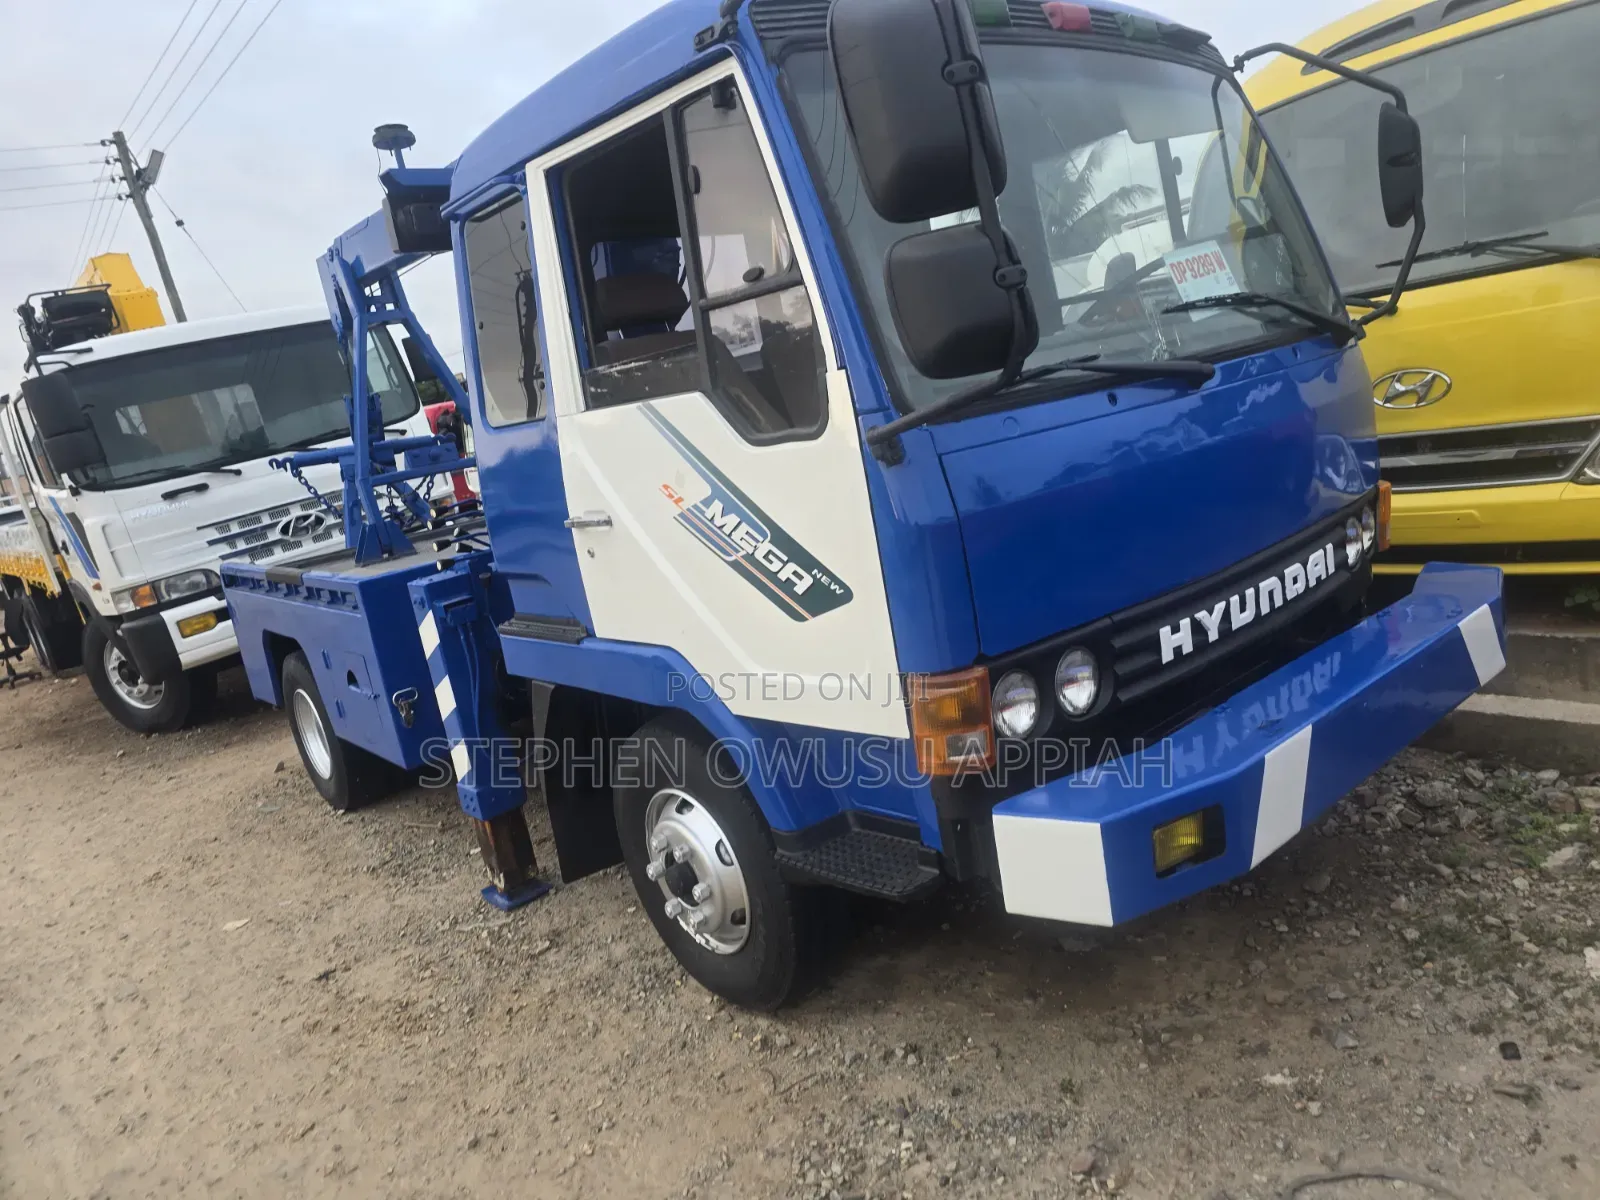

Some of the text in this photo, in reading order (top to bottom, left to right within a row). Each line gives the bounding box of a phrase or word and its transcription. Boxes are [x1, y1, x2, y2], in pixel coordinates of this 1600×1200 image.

[1169, 260, 1188, 285] DP
[1210, 249, 1227, 272] W
[704, 498, 845, 597] MEGA NEW
[1159, 543, 1336, 665] HYUNDAI
